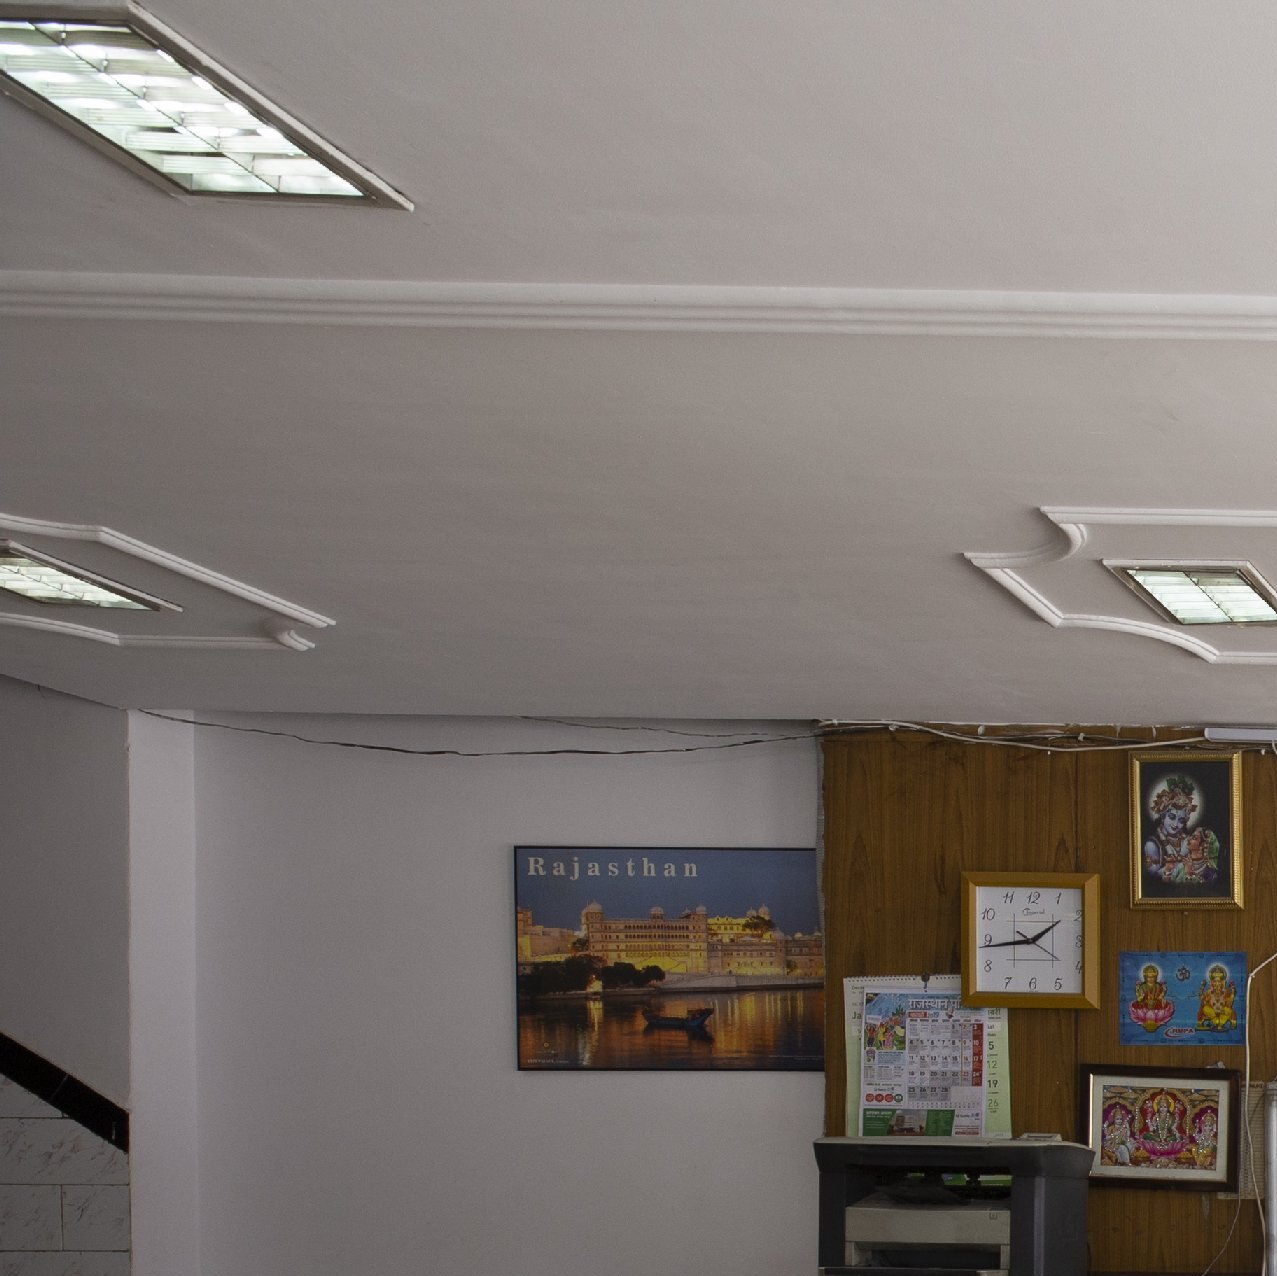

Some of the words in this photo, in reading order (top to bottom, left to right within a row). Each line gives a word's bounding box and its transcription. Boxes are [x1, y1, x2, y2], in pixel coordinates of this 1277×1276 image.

[528, 856, 698, 881] Rajasthan
[1003, 891, 1015, 904] 11
[1027, 891, 1041, 904] 12
[1056, 892, 1062, 904] 1
[981, 908, 996, 920] 10
[984, 934, 992, 947] 9
[984, 960, 992, 973] 8
[1004, 977, 1012, 990] 7
[1029, 977, 1037, 990] 6
[1054, 978, 1063, 990] 5
[988, 1041, 995, 1050] 5
[987, 1061, 998, 1069] 12
[987, 1080, 999, 1088] 19
[988, 1099, 999, 1107] 26
